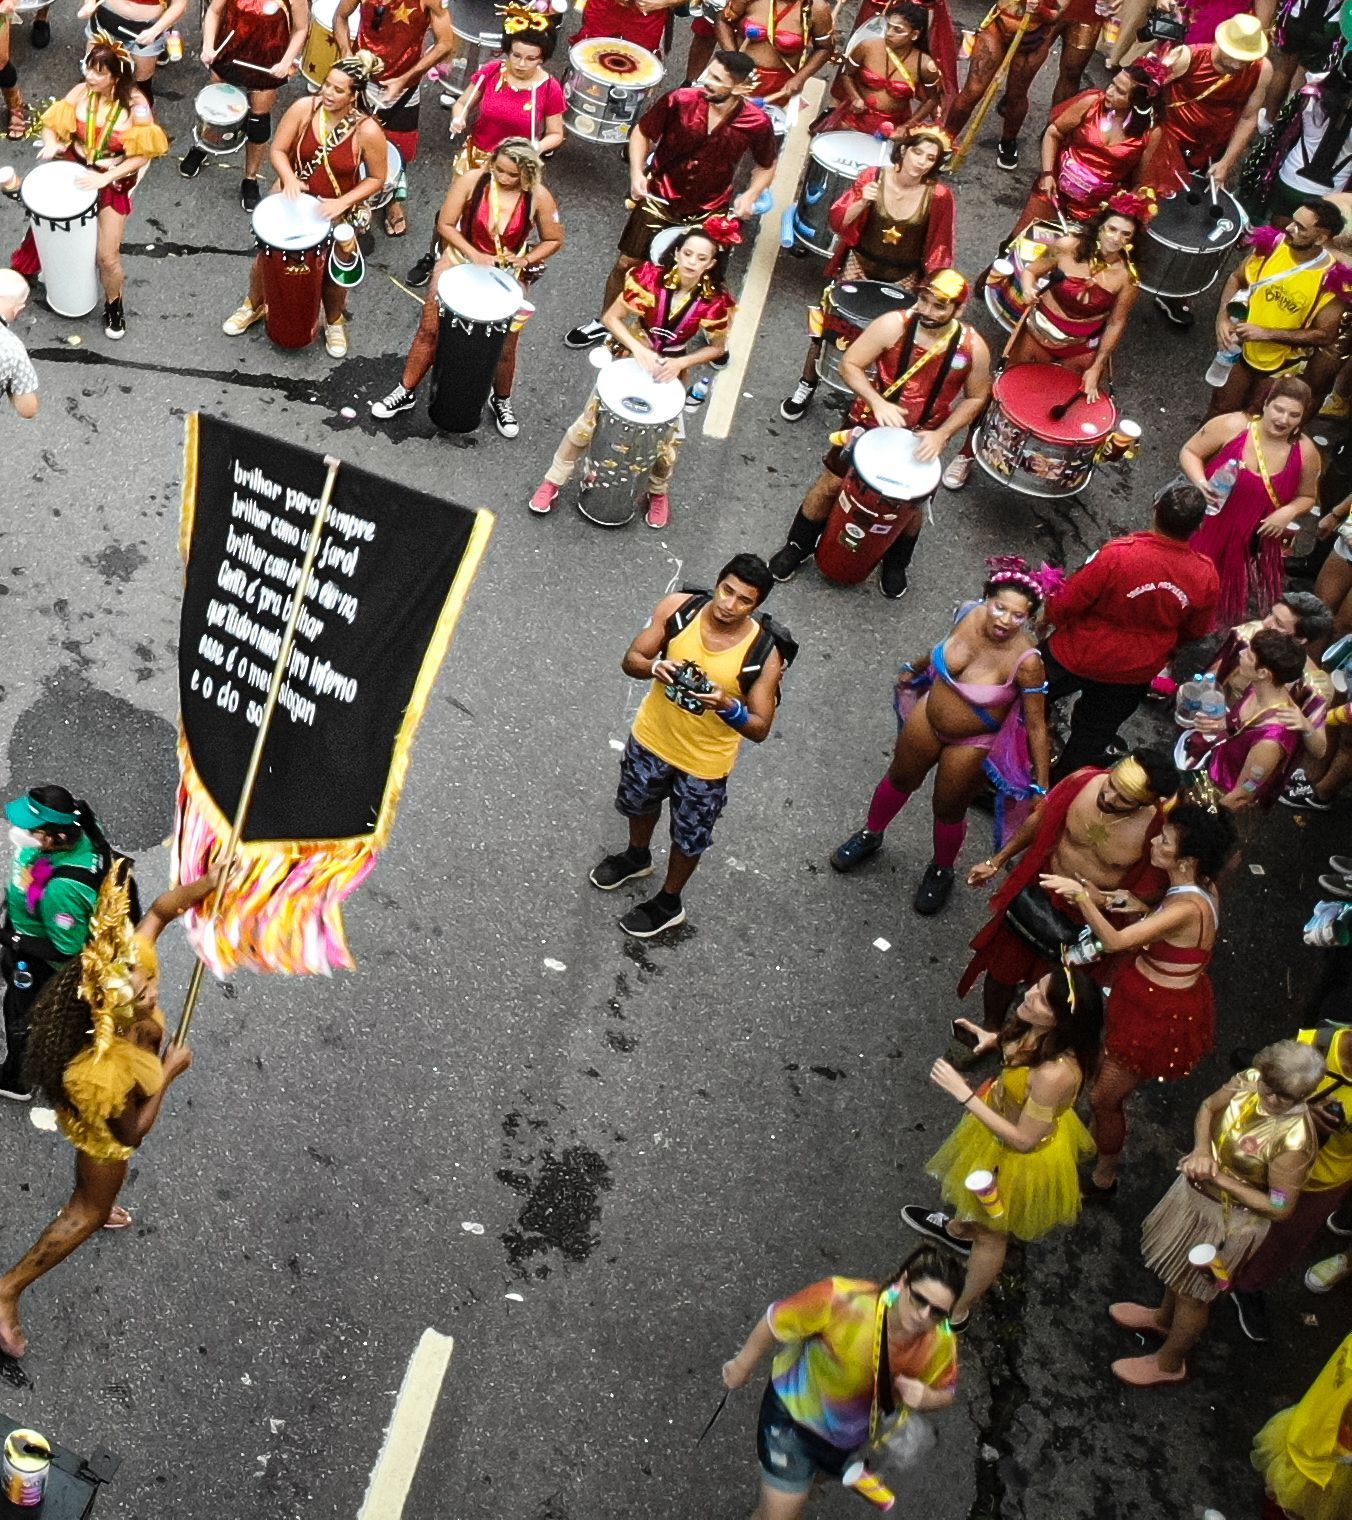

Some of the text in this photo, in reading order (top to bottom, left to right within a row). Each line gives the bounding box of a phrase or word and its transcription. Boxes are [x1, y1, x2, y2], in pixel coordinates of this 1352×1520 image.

[231, 491, 272, 531] brilhar
[271, 516, 300, 546] como
[317, 536, 360, 578] farol
[233, 458, 283, 501] brilhar
[323, 503, 376, 542] sempre
[226, 524, 268, 572] brilhar
[256, 585, 283, 617] pra
[190, 668, 267, 728] e o do so
[198, 633, 225, 666] esse
[225, 646, 239, 673] é
[237, 656, 248, 679] o
[278, 679, 316, 727] slogan
